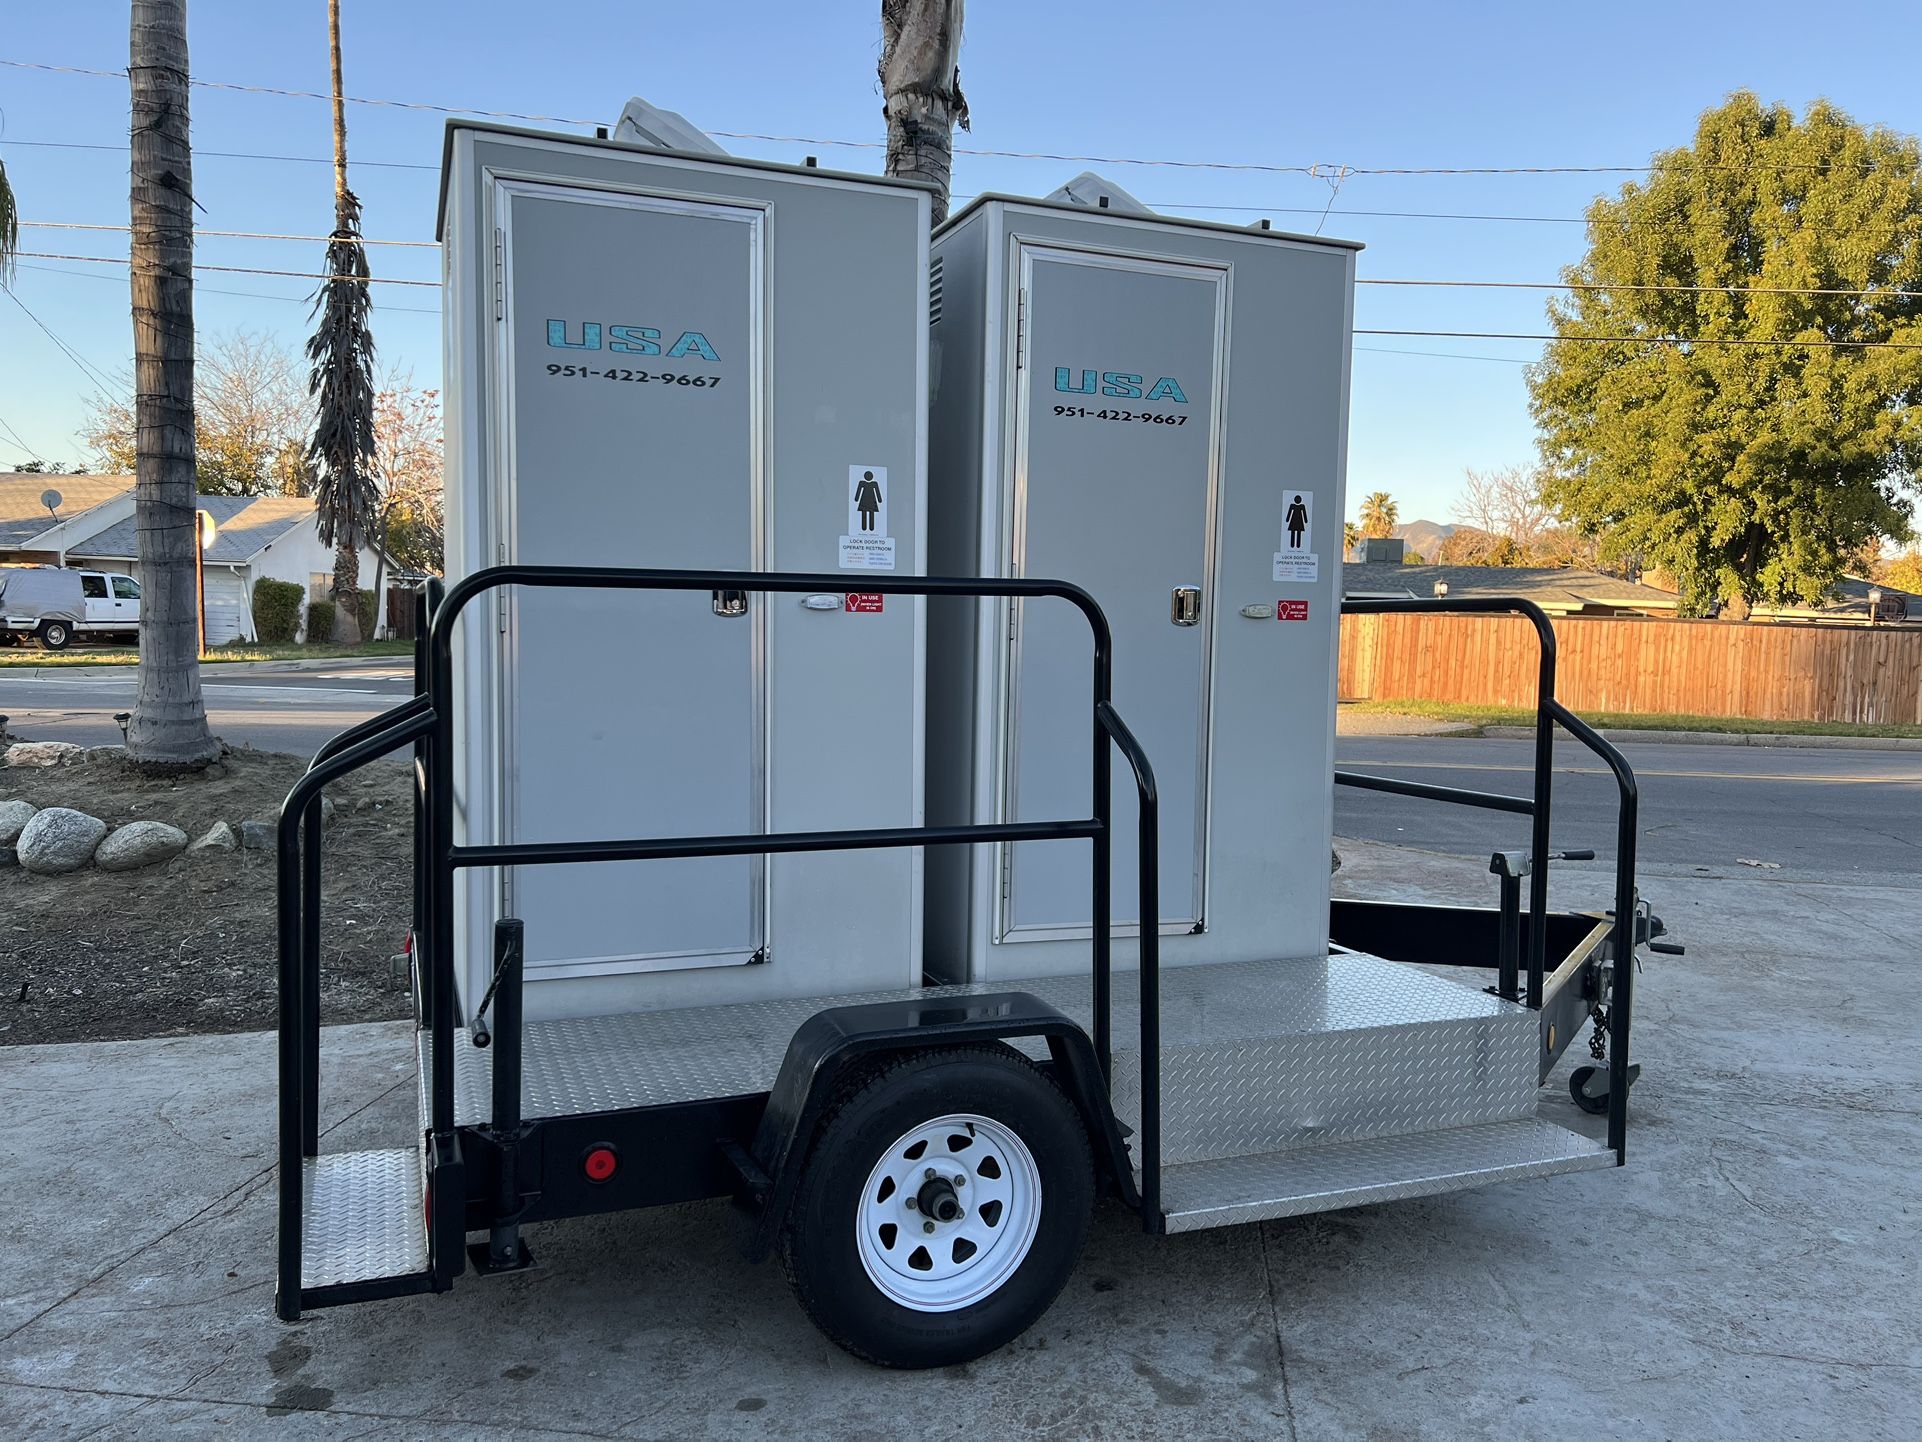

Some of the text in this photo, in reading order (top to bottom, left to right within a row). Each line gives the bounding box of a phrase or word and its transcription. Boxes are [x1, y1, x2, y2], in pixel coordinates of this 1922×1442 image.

[546, 318, 722, 362] USA
[546, 364, 722, 388] 951-422-9667
[1054, 366, 1189, 404] USA
[1053, 405, 1188, 426] 951-422-9667
